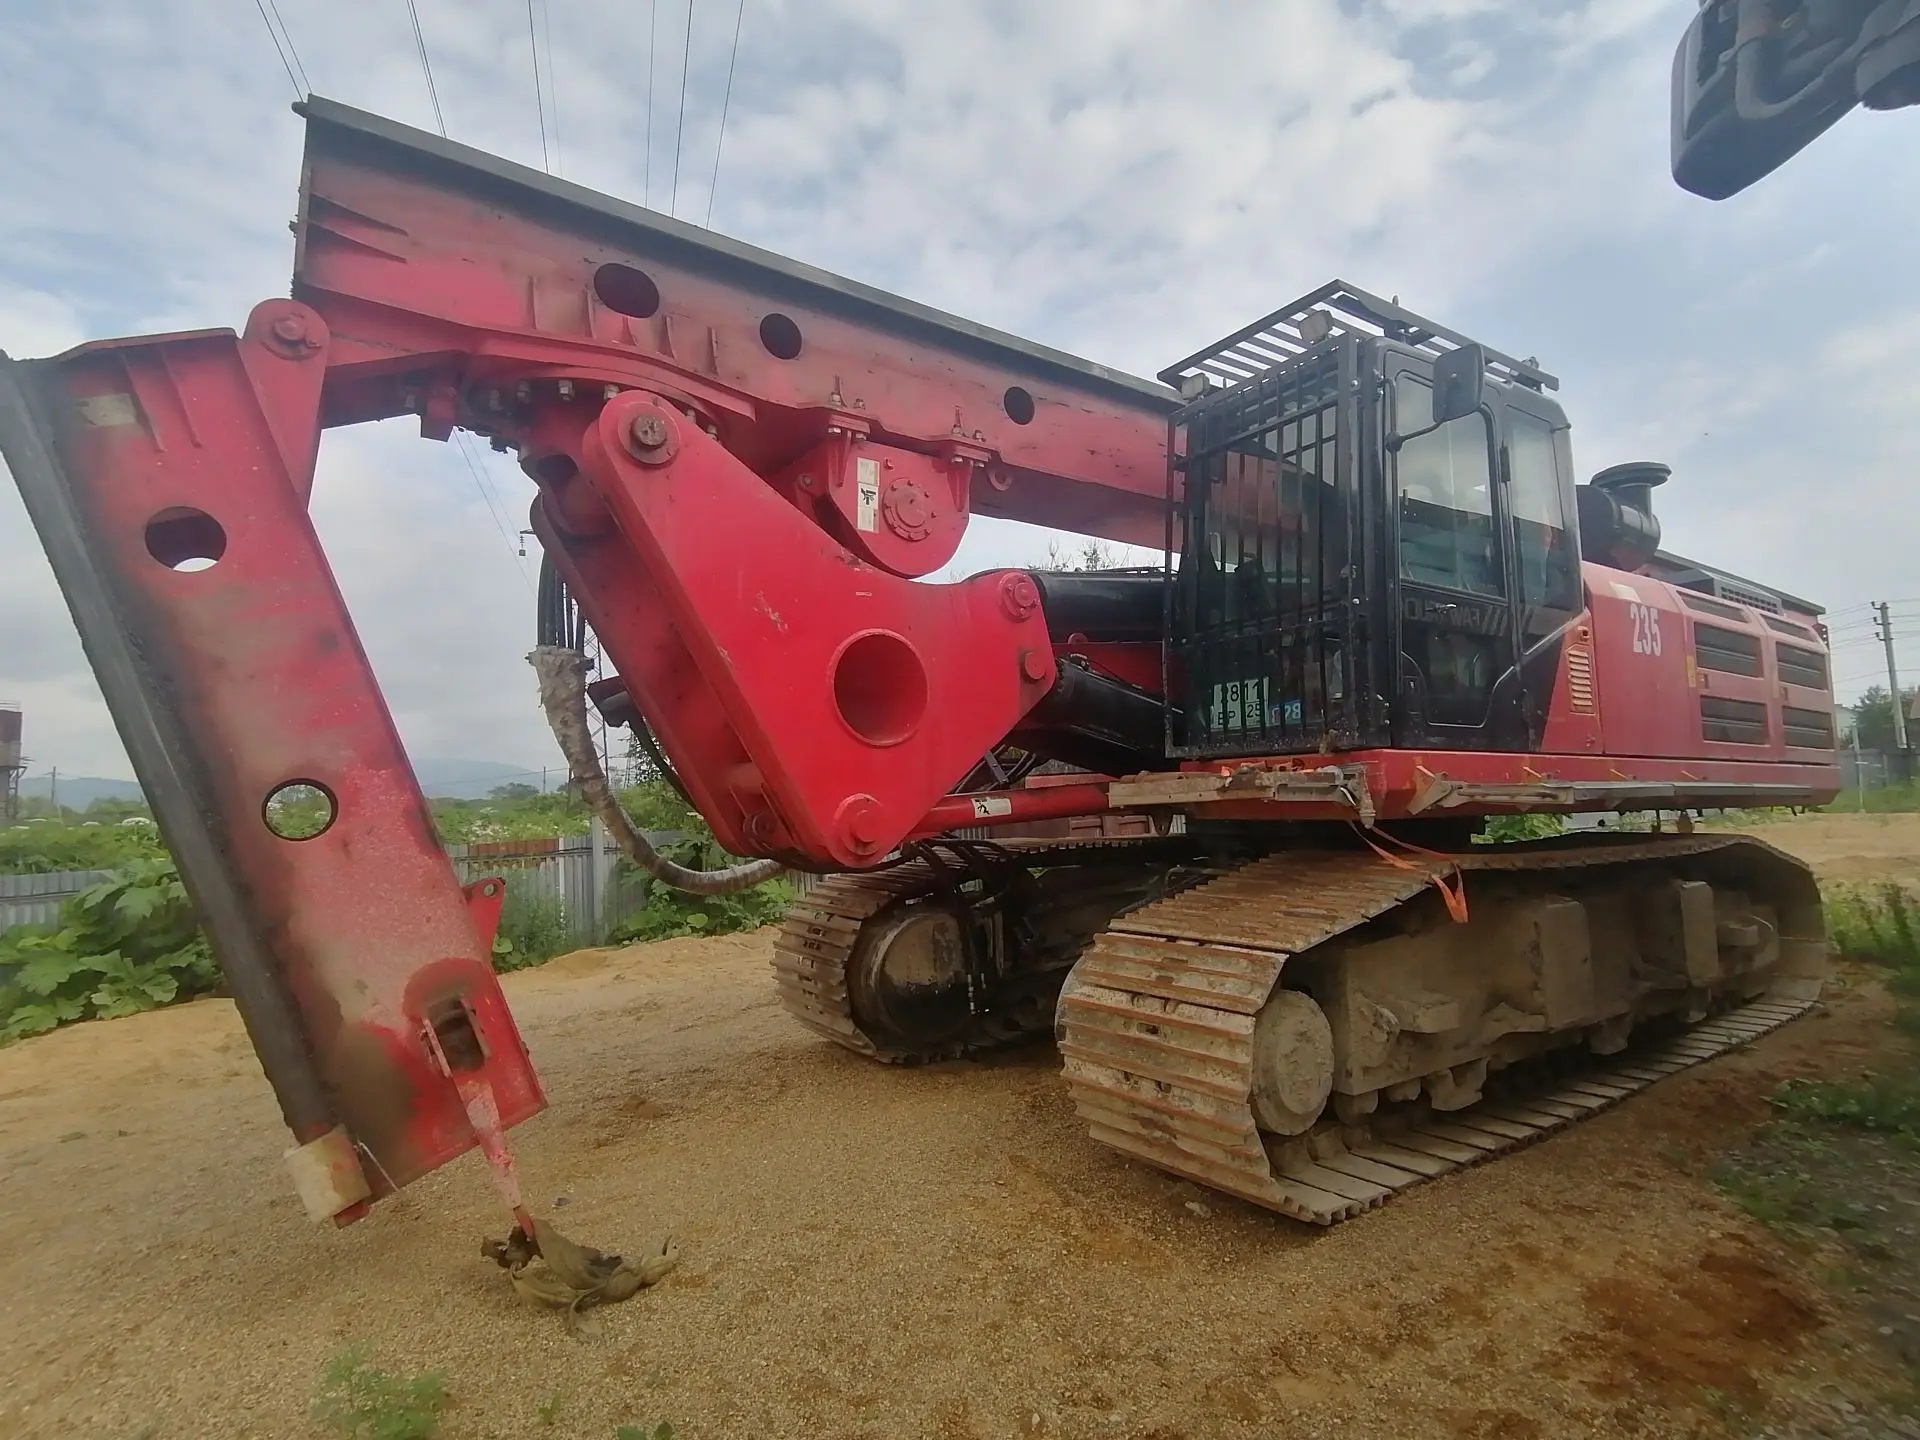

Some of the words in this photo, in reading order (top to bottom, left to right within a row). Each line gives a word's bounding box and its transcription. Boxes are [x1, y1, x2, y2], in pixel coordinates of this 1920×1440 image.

[1630, 602, 1661, 656] 235
[1221, 682, 1261, 702] 811
[1246, 704, 1261, 718] 25
